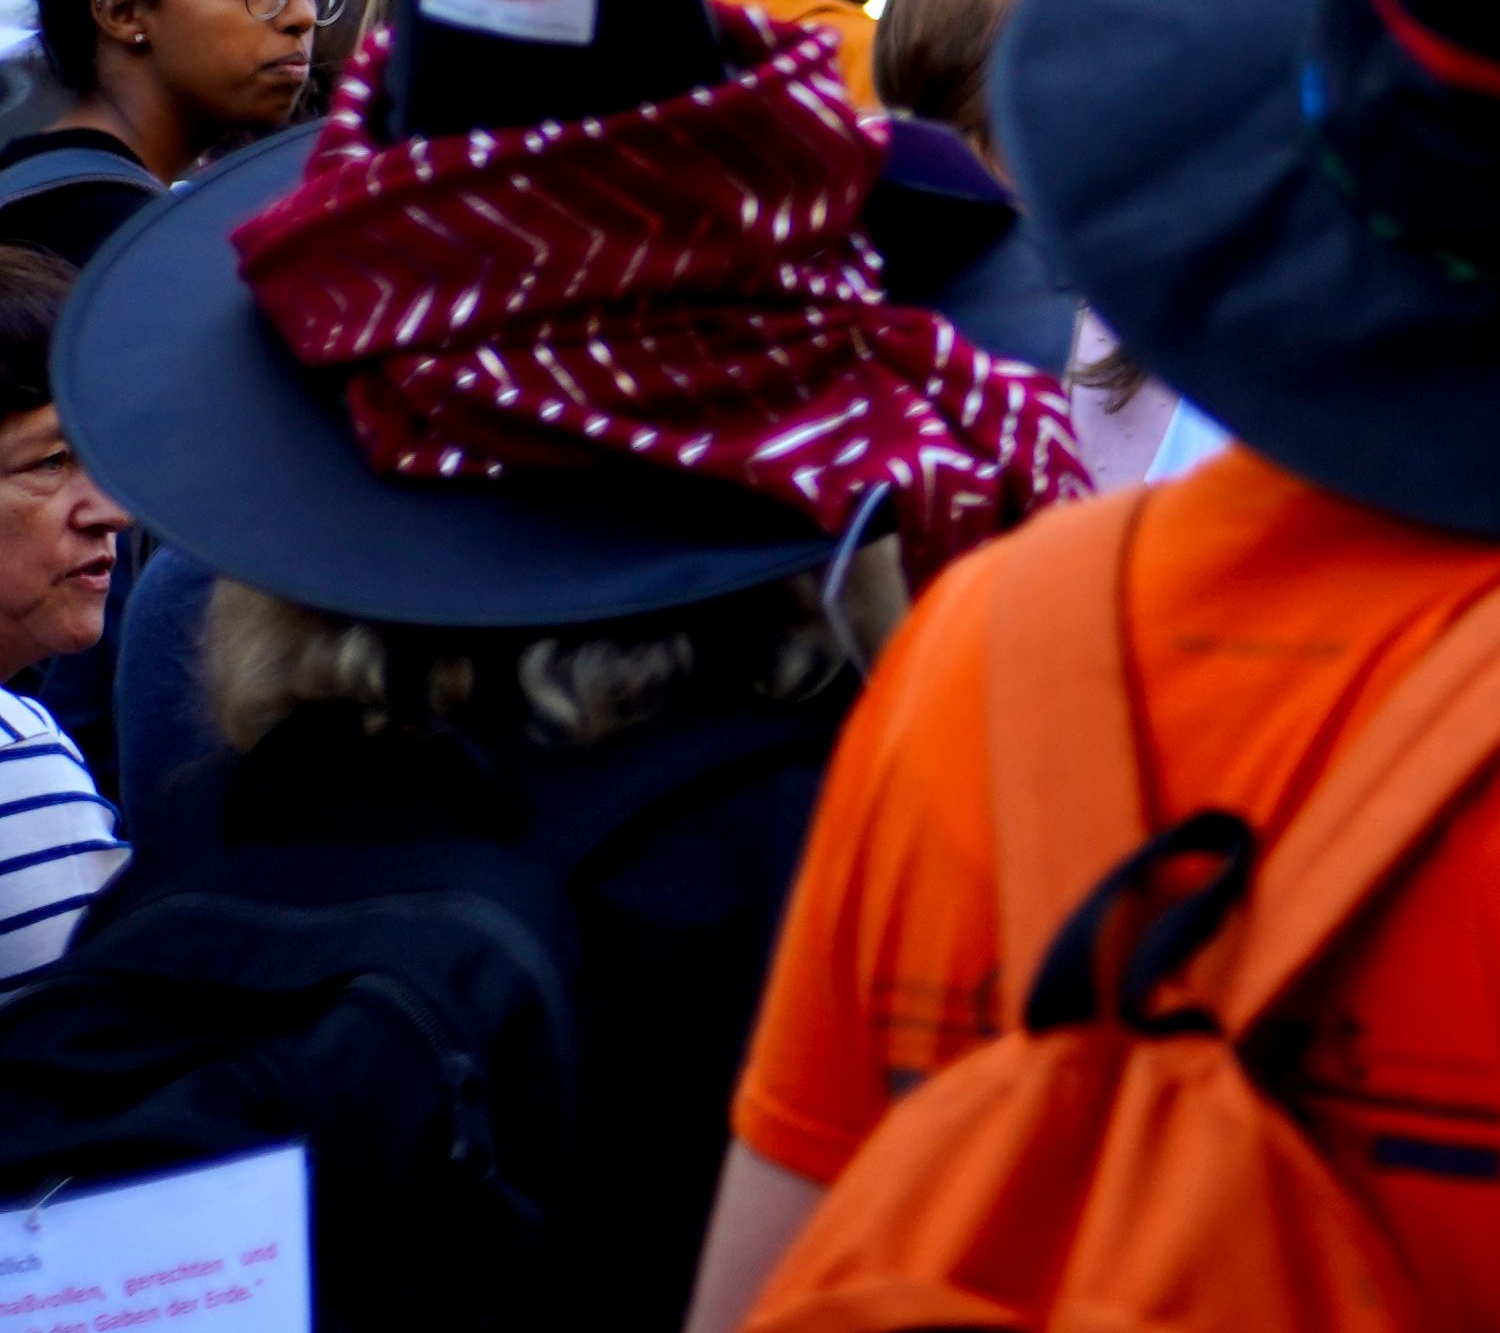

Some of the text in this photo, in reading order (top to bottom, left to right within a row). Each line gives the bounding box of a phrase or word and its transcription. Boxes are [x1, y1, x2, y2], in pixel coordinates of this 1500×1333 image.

[123, 1257, 226, 1298] gerechten
[240, 1241, 279, 1267] und
[93, 1306, 161, 1332] Gaben
[165, 1297, 200, 1318] der
